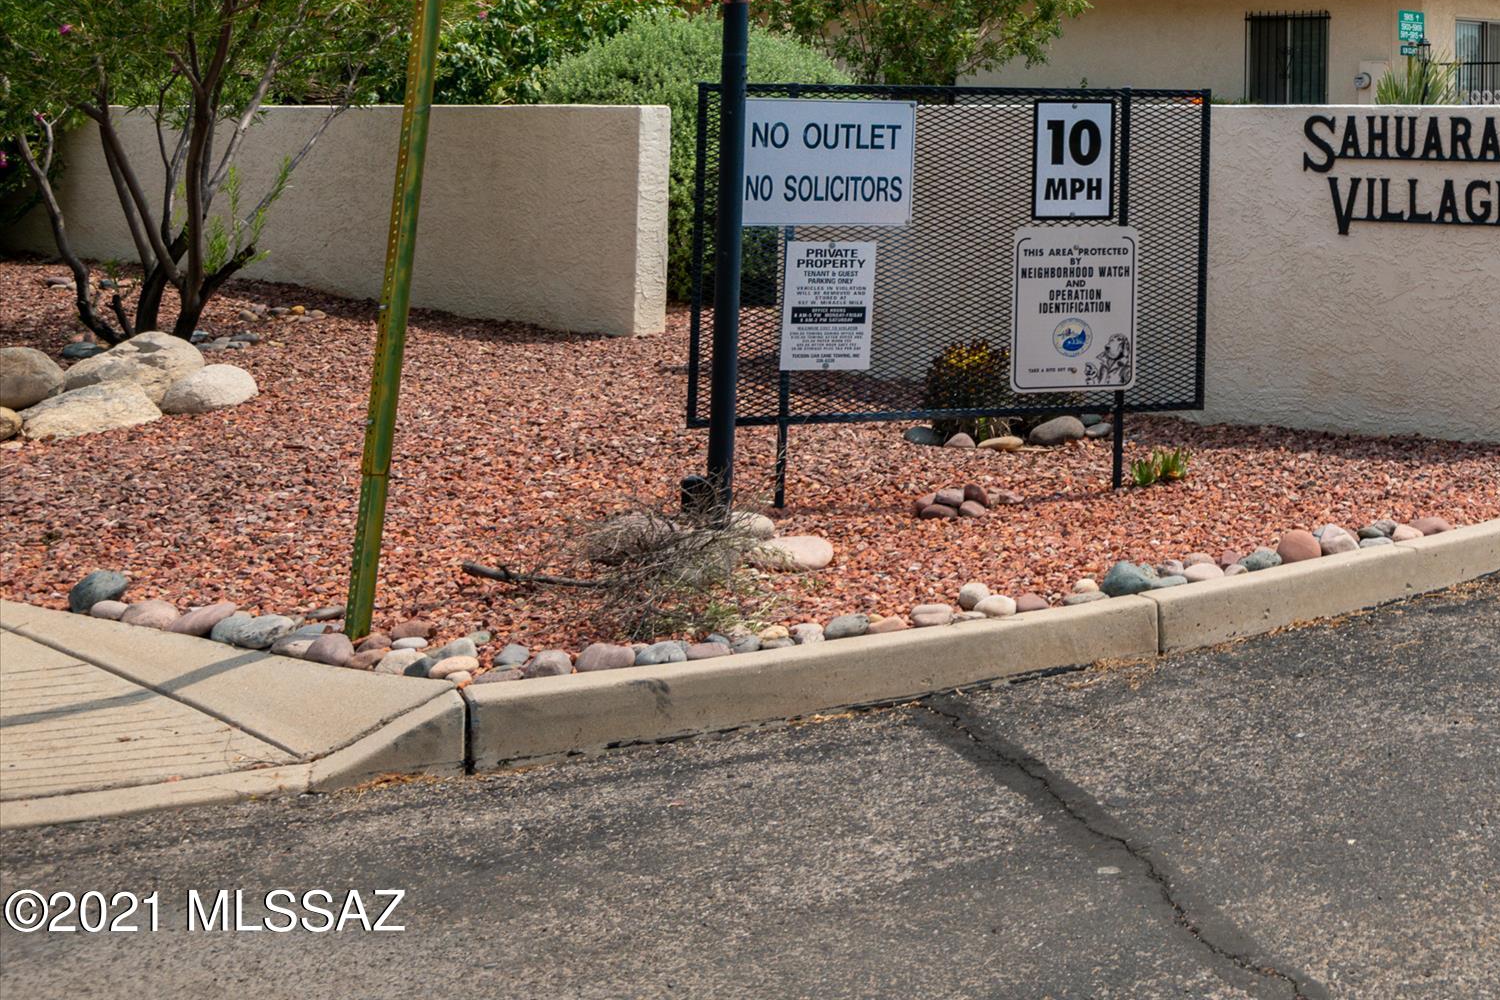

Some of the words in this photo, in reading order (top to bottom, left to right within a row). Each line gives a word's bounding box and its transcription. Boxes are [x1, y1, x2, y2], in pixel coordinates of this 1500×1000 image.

[751, 122, 789, 149] NO
[802, 123, 902, 149] OUTLET
[1047, 119, 1102, 166] 10
[745, 174, 774, 201] NO
[783, 174, 903, 202] SOLICITORS
[1044, 178, 1102, 200] MPH
[806, 249, 858, 258] PRIVATE
[1023, 248, 1044, 256] THIS
[1049, 248, 1073, 256] AREA
[1078, 247, 1129, 256] PROTECTED
[797, 259, 866, 268] PROPERTY
[1070, 257, 1082, 265] BY
[1021, 266, 1094, 279] NEIGHBORHOOD
[1098, 266, 1130, 277] WATCH
[1049, 289, 1102, 301] OPERATION
[1039, 301, 1111, 314] IDENTIFICATION
